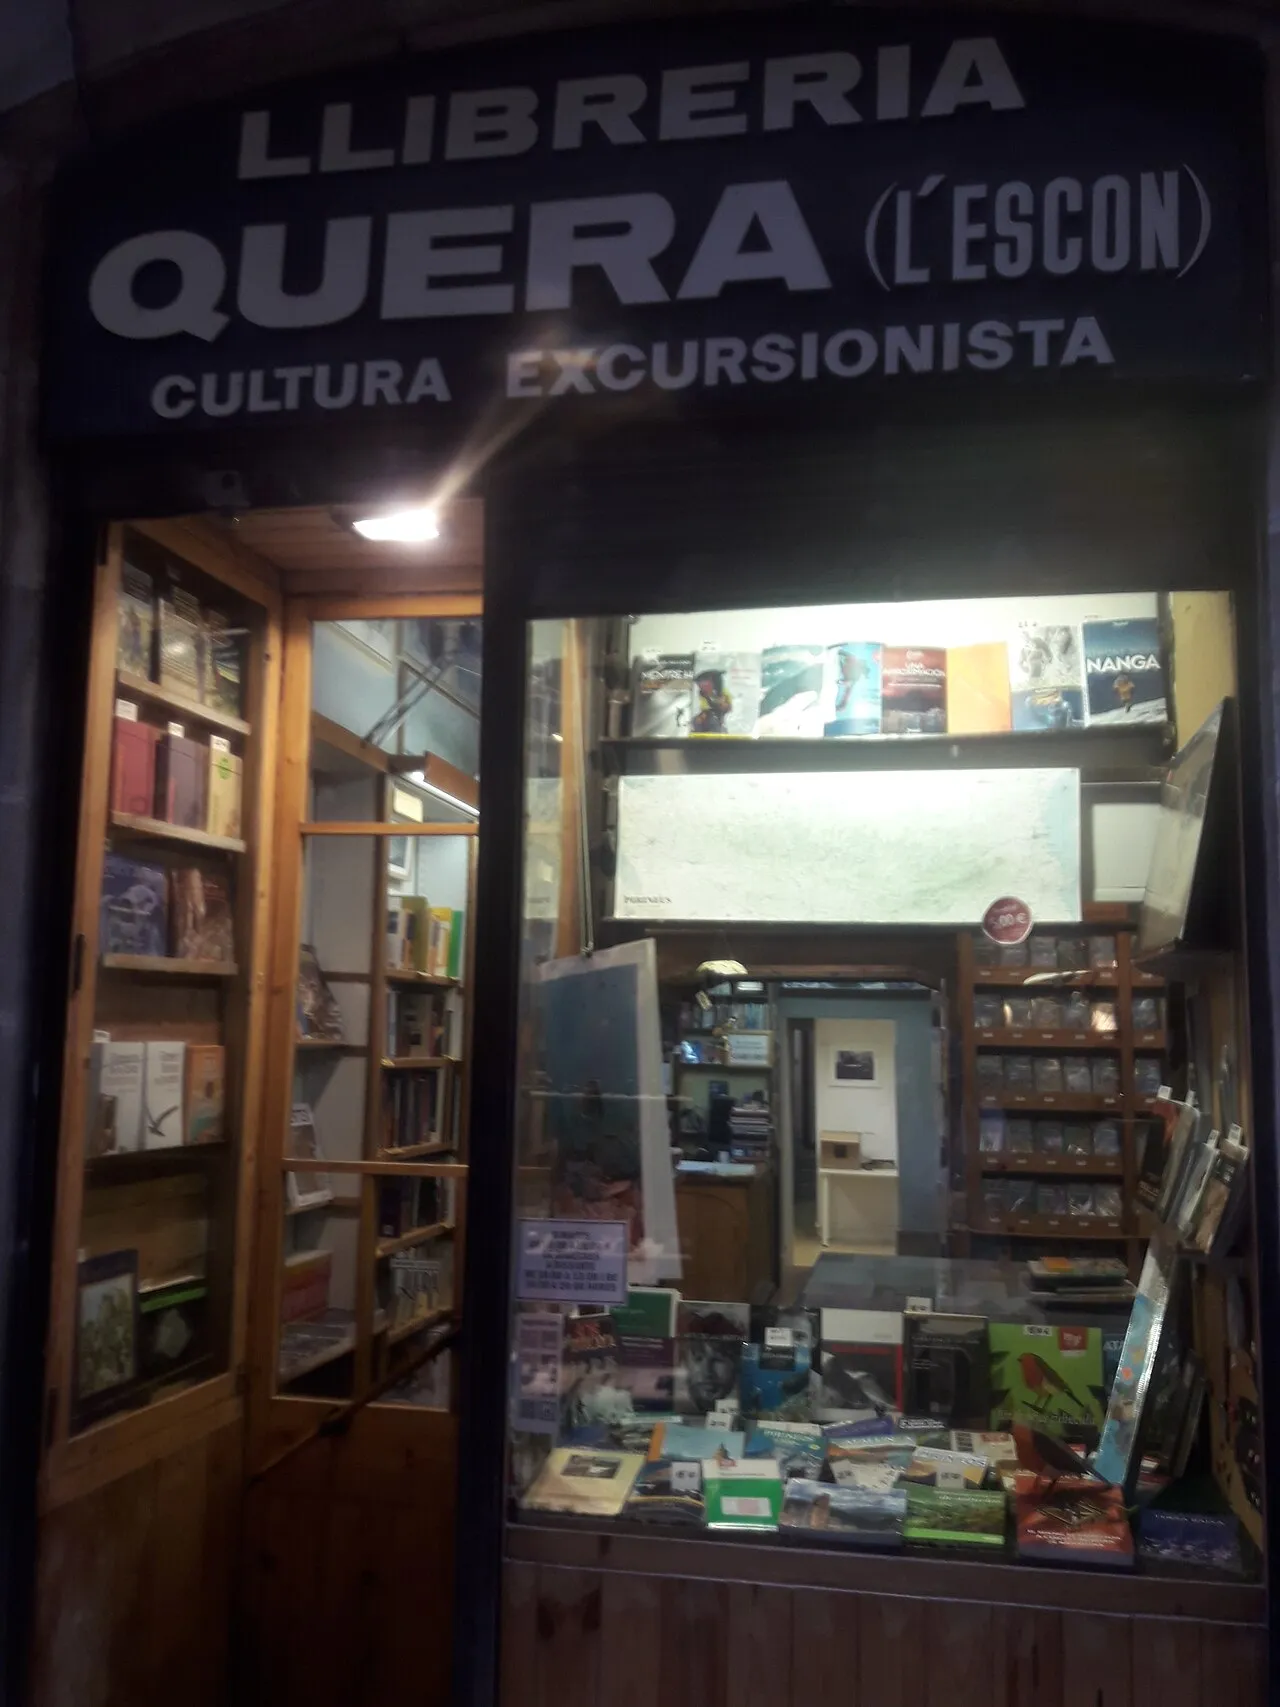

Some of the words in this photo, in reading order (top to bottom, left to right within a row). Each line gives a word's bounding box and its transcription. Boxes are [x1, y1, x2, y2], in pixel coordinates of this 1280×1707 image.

[237, 37, 1026, 180] LLIBRERIA
[89, 180, 833, 343] QUERA
[150, 357, 452, 420] CULTURA
[505, 316, 1116, 398] EXCURSIONISTA
[1086, 653, 1161, 673] NANGA
